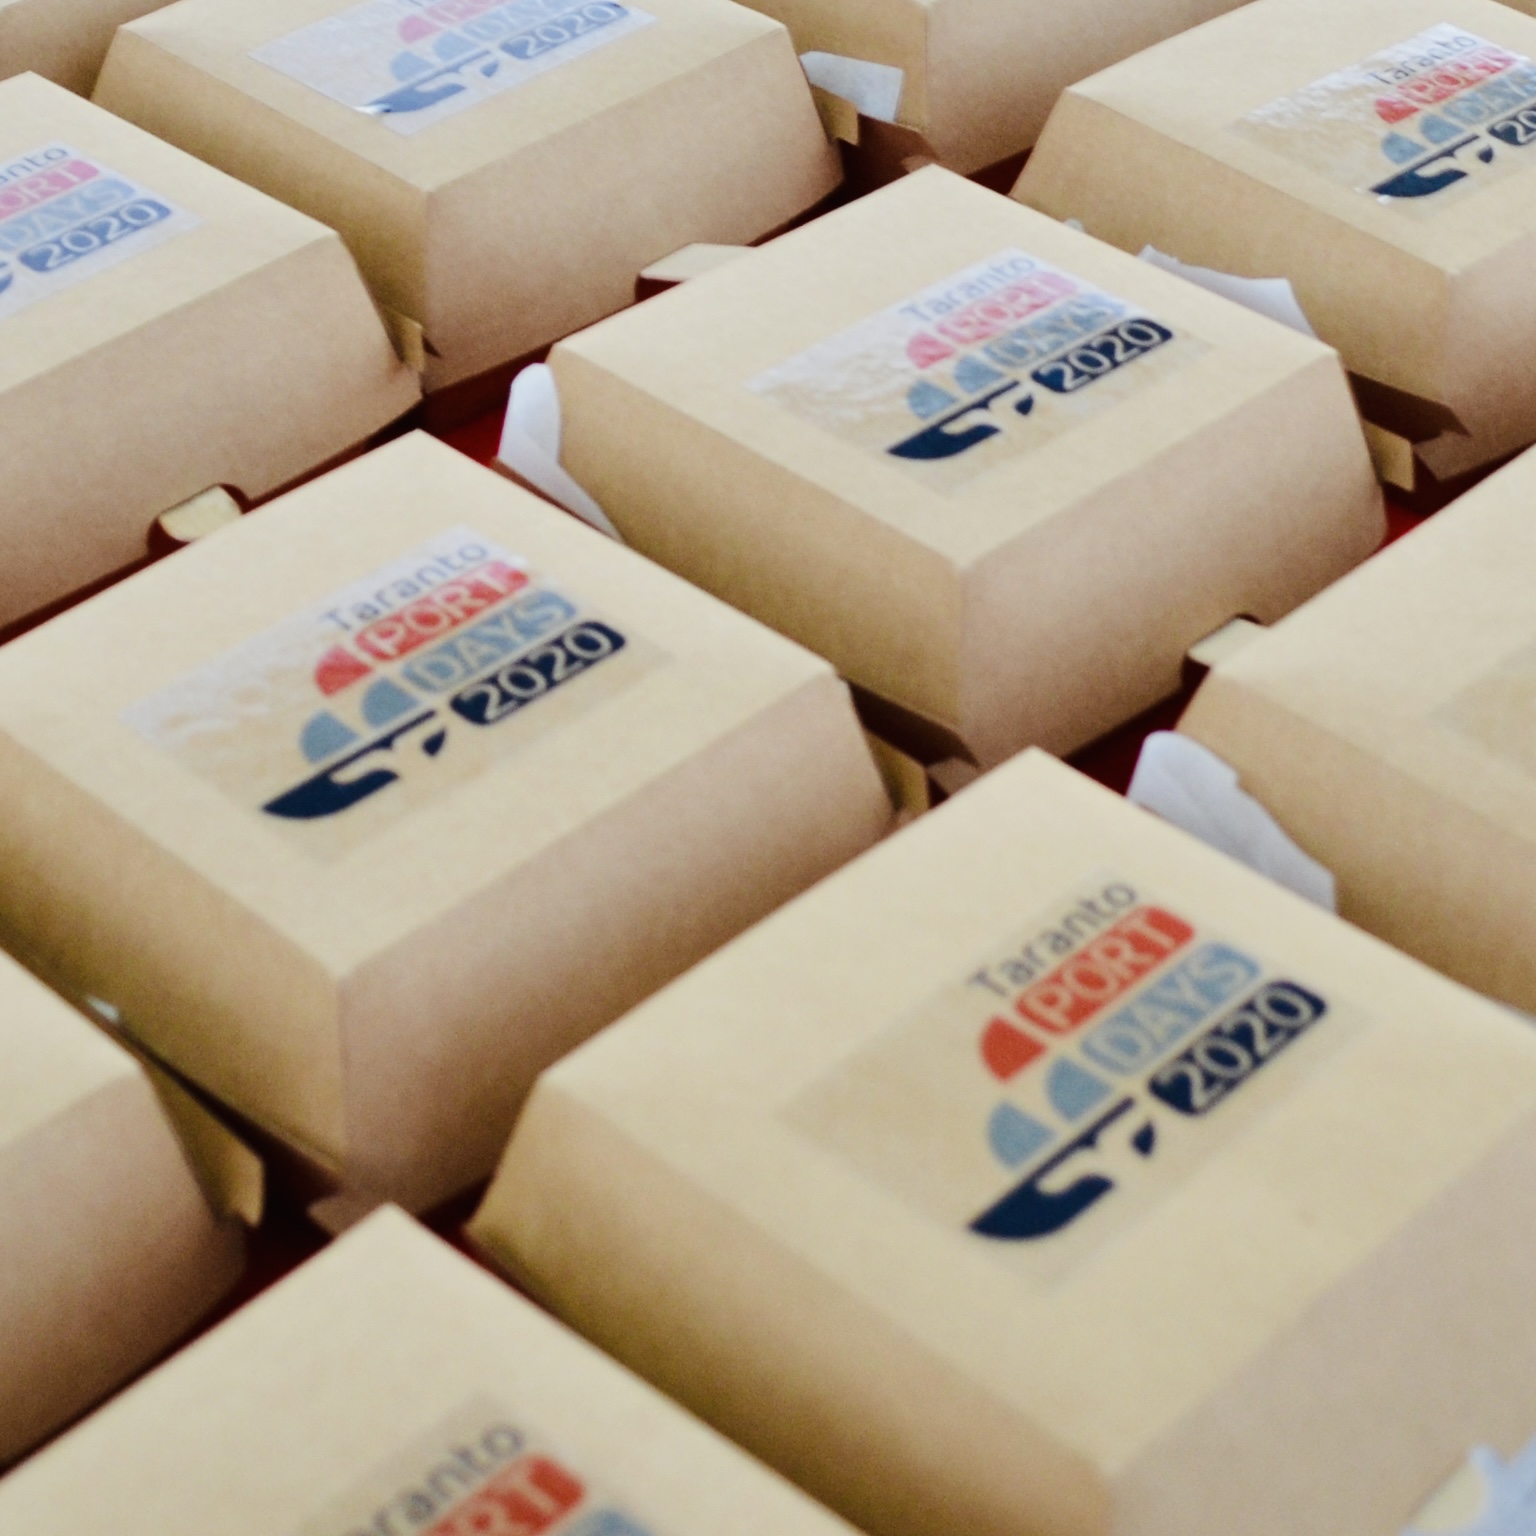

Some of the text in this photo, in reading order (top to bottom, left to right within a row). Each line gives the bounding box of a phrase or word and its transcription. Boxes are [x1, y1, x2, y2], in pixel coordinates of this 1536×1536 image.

[515, 4, 616, 56] 2020
[1369, 36, 1476, 84] Taranto
[39, 199, 159, 264] 2020
[900, 256, 1034, 319] Taranto
[1050, 318, 1159, 385] 2020
[322, 541, 488, 626] Taranto
[369, 563, 511, 657] PORT
[419, 596, 569, 686] DAYS
[473, 626, 611, 719] 2020
[971, 883, 1136, 996] Taranto
[1023, 911, 1175, 1035] PORT
[1089, 950, 1247, 1070] DAYS
[1160, 984, 1313, 1112] 2020
